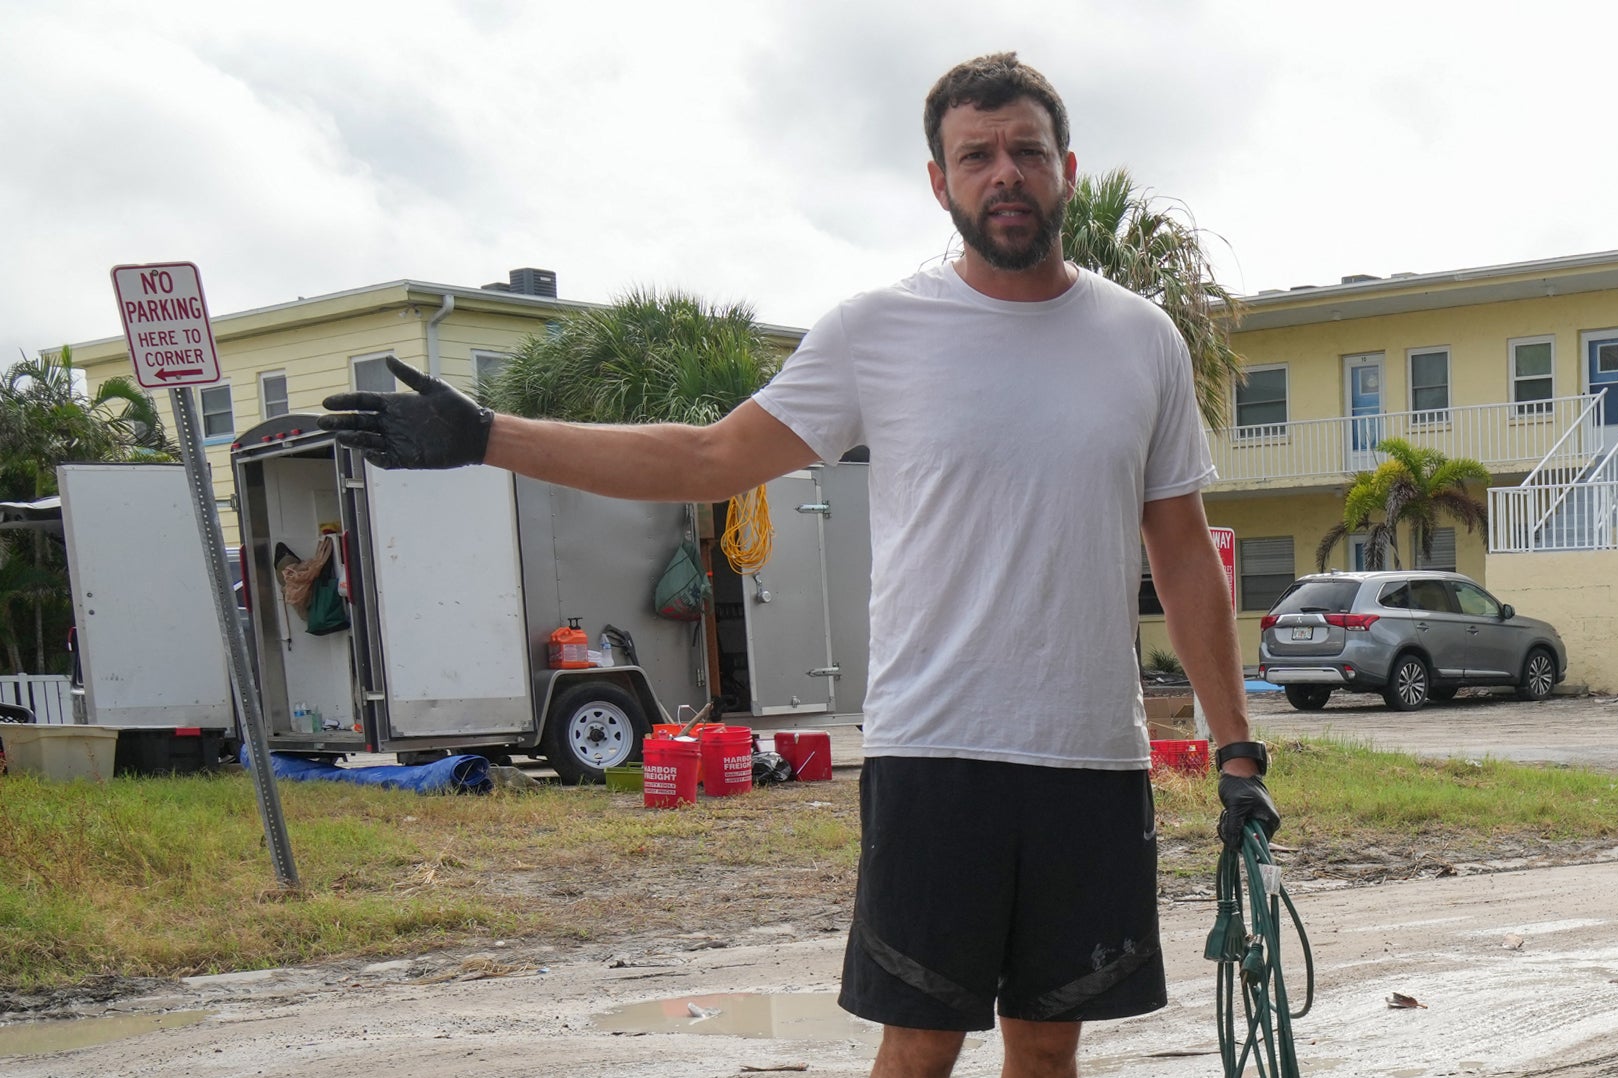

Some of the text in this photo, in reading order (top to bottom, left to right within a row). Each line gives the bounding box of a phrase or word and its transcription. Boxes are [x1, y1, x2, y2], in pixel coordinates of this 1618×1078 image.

[140, 271, 173, 294] NO
[125, 297, 201, 323] PARKING
[138, 328, 201, 347] HERE TO
[145, 348, 205, 367] CORNER
[724, 761, 752, 770] FREIGH
